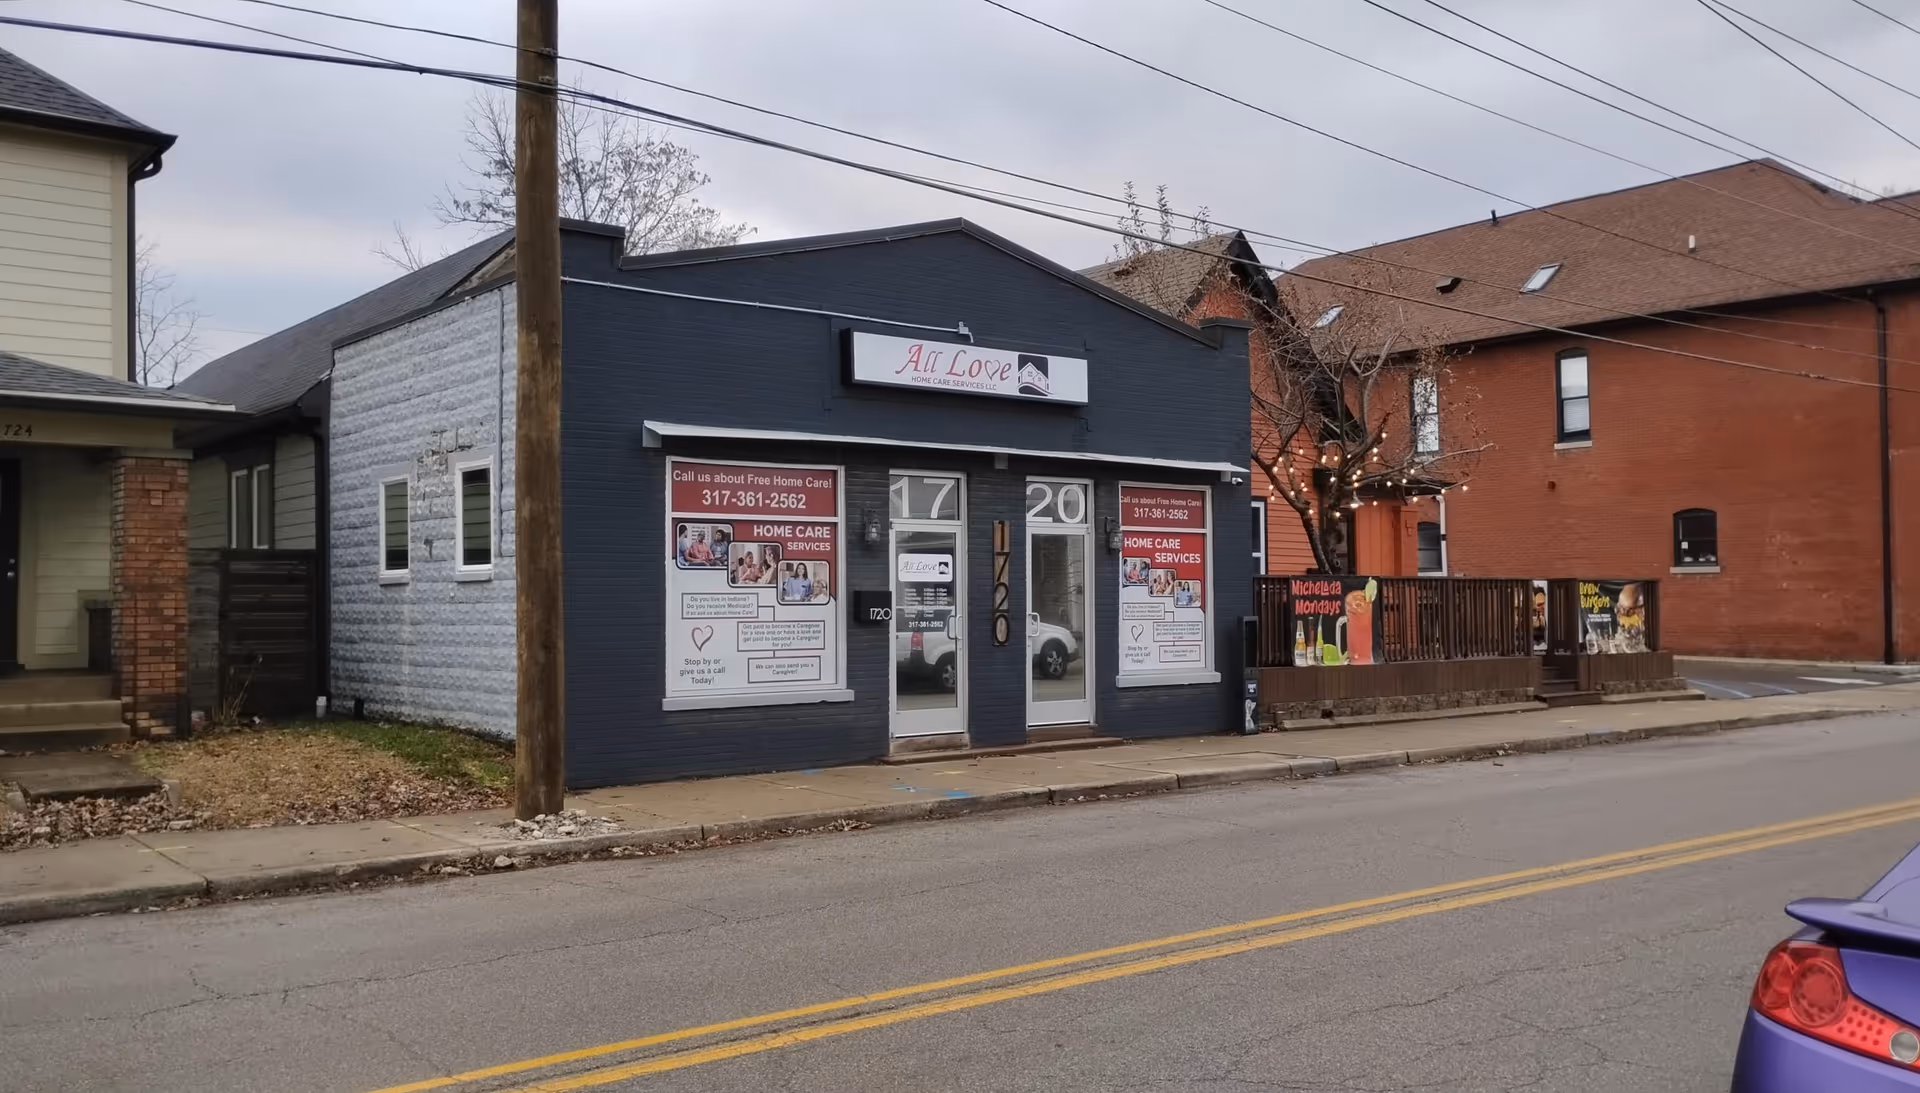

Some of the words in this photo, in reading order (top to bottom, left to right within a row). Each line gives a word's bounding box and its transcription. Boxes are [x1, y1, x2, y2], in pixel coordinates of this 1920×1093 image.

[895, 344, 943, 374] All
[912, 376, 931, 384] HOME
[933, 378, 950, 386] CARE
[952, 380, 984, 389] SERVICES
[4, 424, 32, 436] 724
[673, 470, 694, 482] Call
[698, 473, 711, 482] us
[714, 473, 744, 484] about
[748, 474, 770, 485] Free
[774, 476, 802, 487] Home
[806, 477, 832, 488] Care!
[702, 489, 806, 509] 317-361-2562
[890, 476, 955, 519] 17
[1026, 483, 1085, 524] 20
[1187, 499, 1202, 507] Care!
[1134, 507, 1188, 519] 317-361-2562
[754, 525, 792, 537] HOME
[796, 526, 831, 538] CARE
[787, 542, 830, 551] SERVICES
[1124, 537, 1153, 548] HOME
[1155, 539, 1181, 549] CARE
[1155, 552, 1201, 563] SERVICES
[993, 520, 1010, 644] 1720
[870, 608, 892, 620] 1720
[1295, 600, 1341, 616] Mondays
[684, 658, 701, 666] Stop
[703, 658, 711, 666] by
[680, 668, 695, 677] give
[691, 677, 714, 685] Today!
